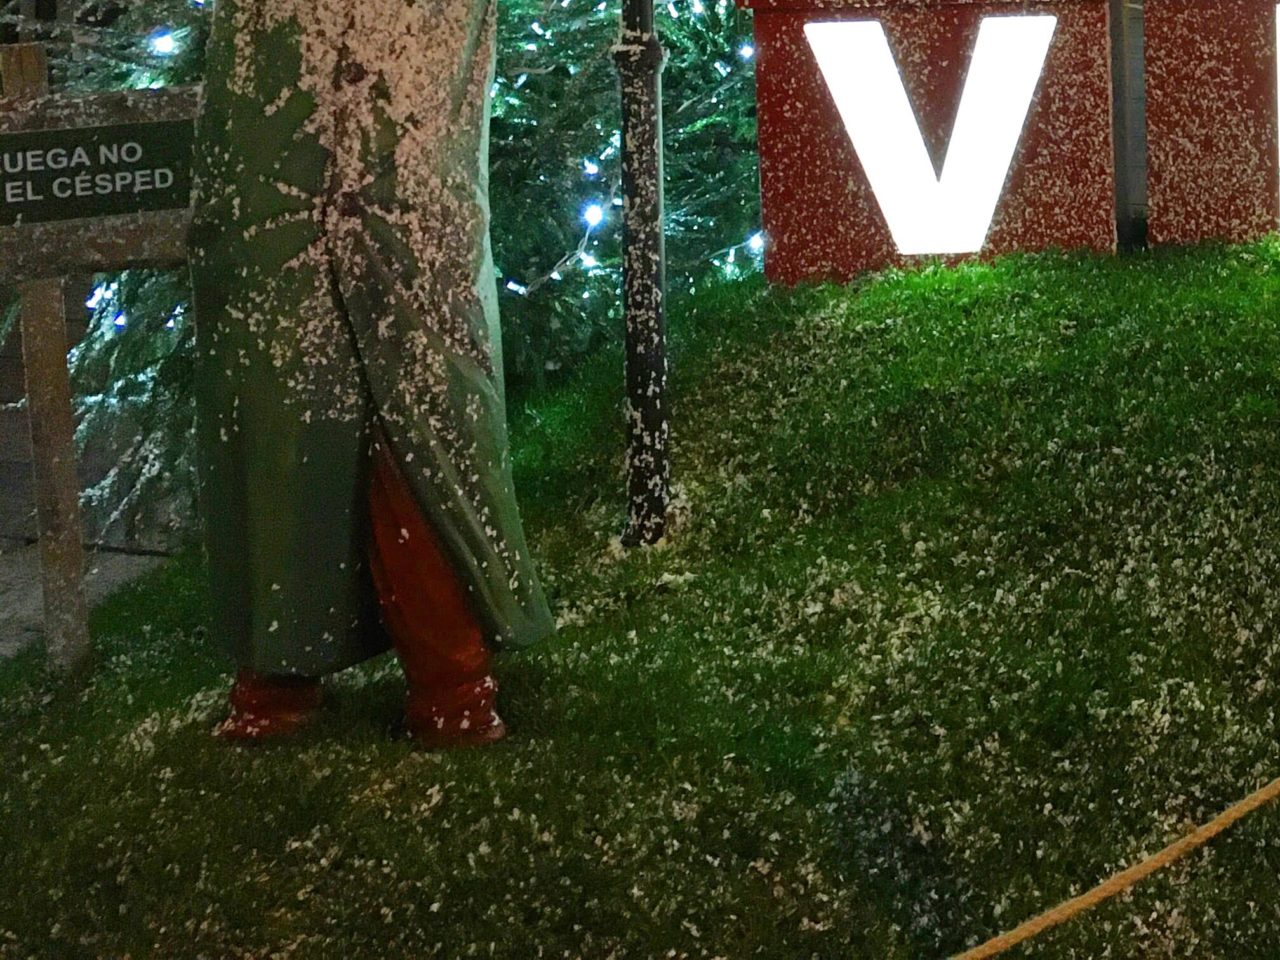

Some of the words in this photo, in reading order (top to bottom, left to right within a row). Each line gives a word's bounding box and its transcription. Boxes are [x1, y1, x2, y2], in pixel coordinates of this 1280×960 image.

[100, 142, 143, 165] NO
[5, 181, 43, 203] EL
[52, 168, 174, 198] CÉSPED
